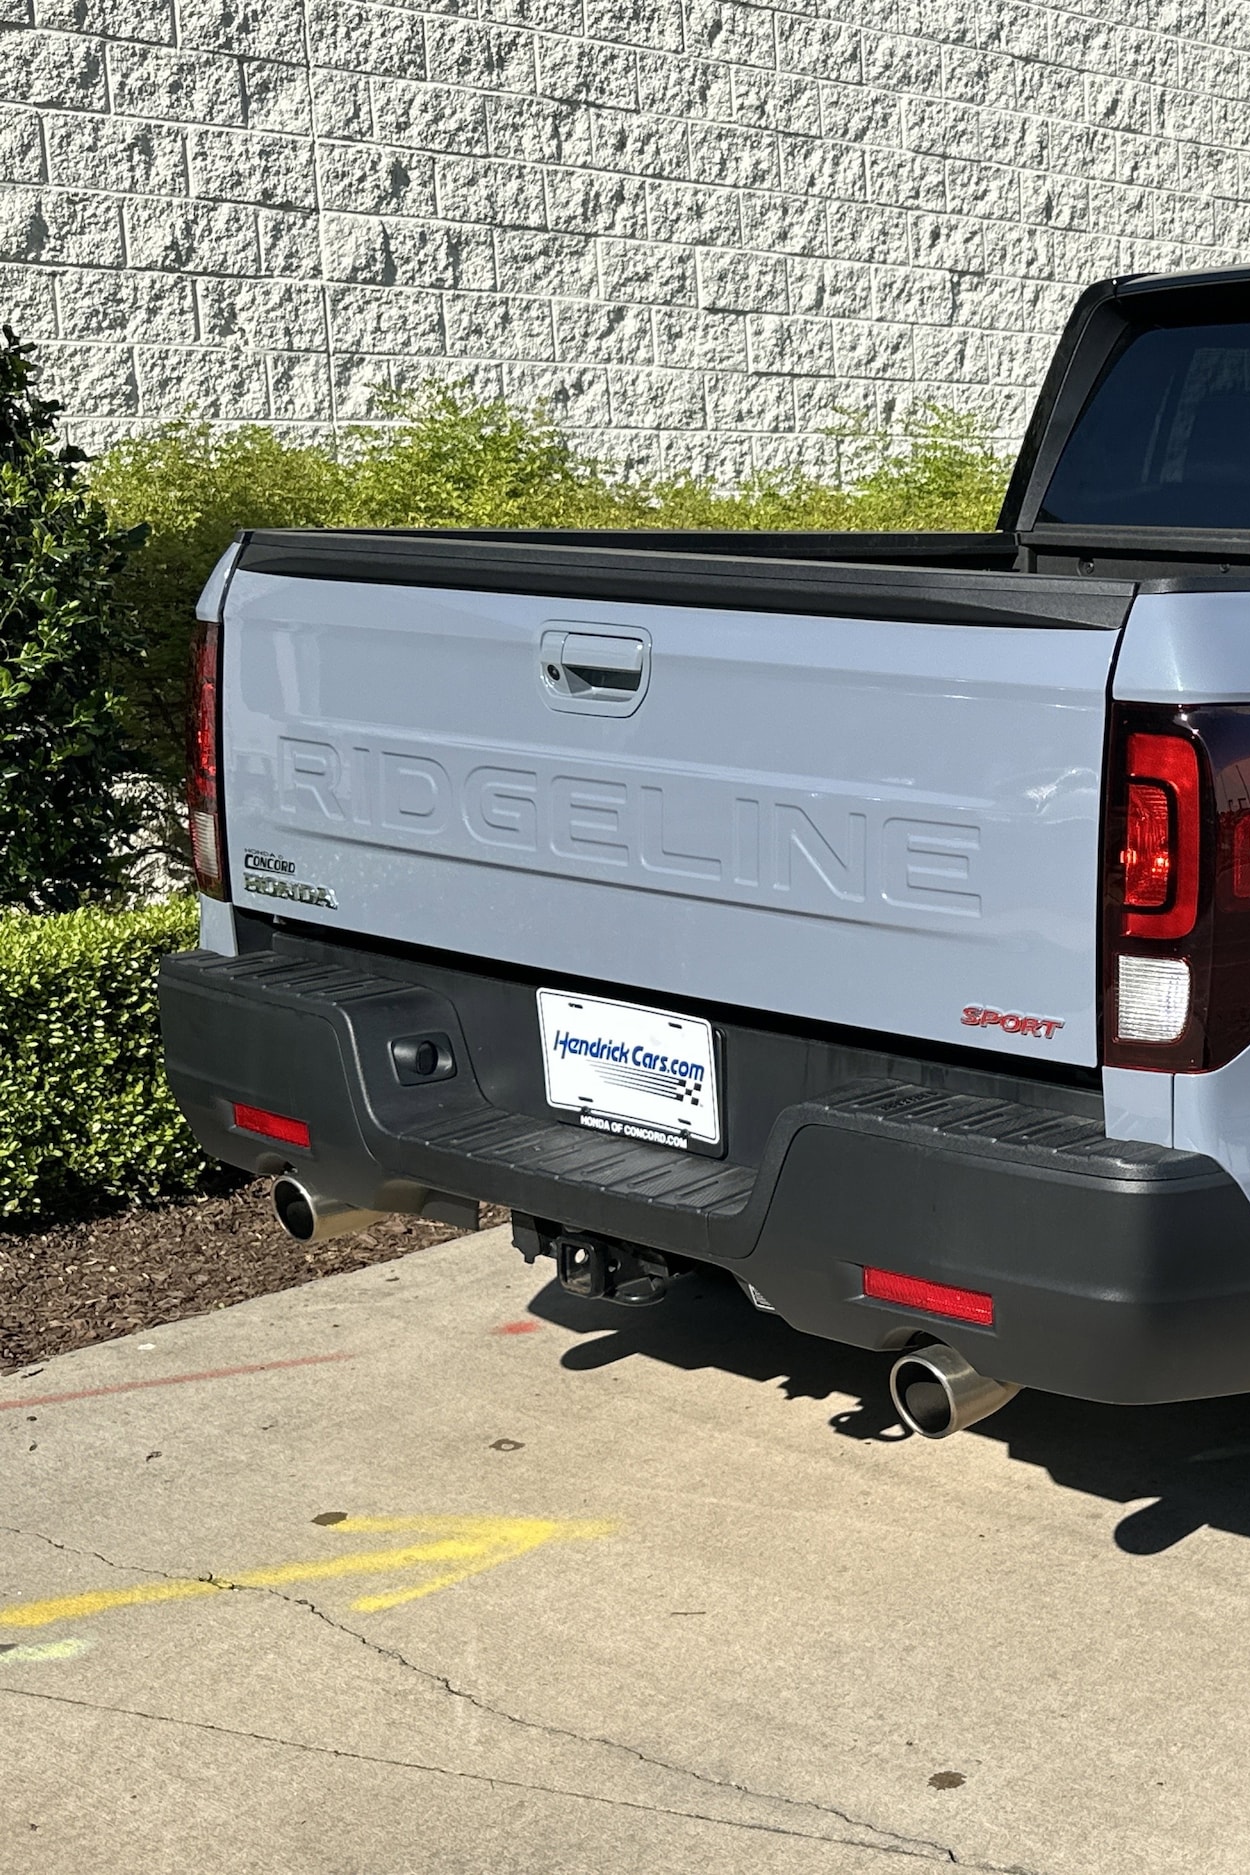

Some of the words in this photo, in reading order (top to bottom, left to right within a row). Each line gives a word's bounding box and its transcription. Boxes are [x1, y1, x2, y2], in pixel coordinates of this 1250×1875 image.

[277, 735, 983, 919] RIDGELINE
[244, 854, 296, 876] CONCORD
[243, 872, 339, 911] HONDA
[960, 1006, 1066, 1040] SPORT
[580, 1114, 610, 1132] HONDA
[611, 1121, 623, 1133] OF
[624, 1125, 688, 1149] CONCORD.COM
